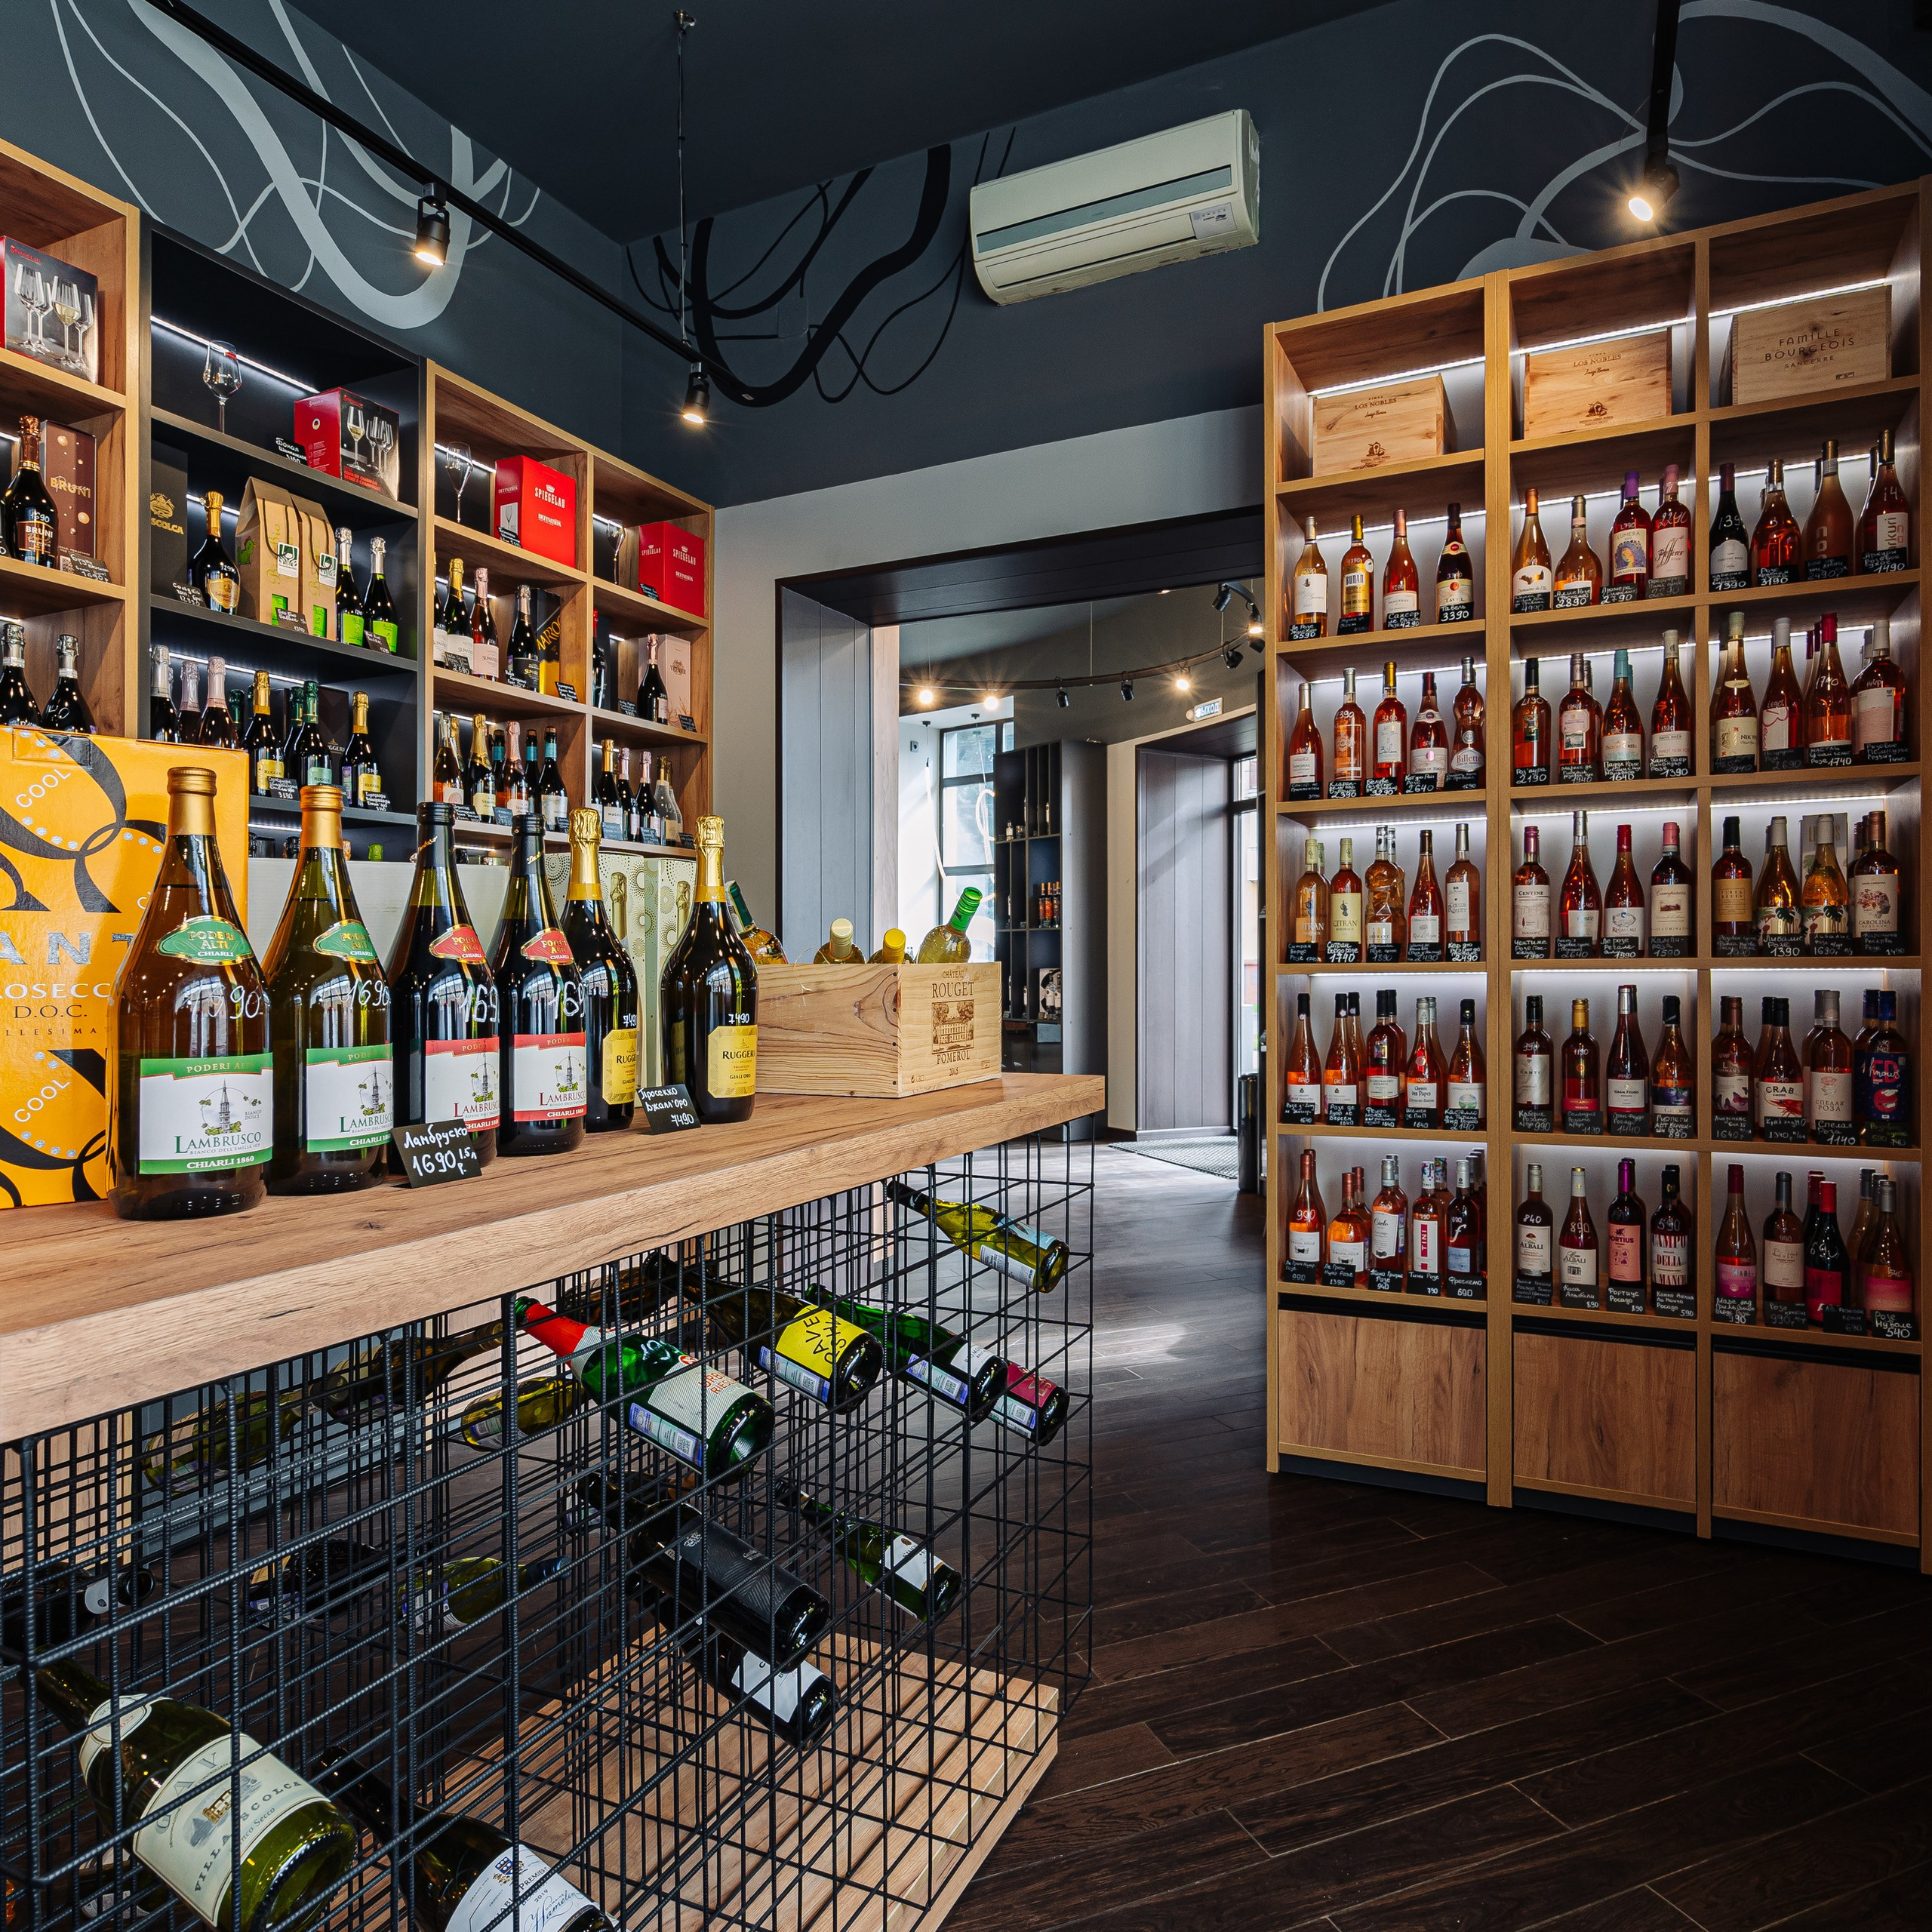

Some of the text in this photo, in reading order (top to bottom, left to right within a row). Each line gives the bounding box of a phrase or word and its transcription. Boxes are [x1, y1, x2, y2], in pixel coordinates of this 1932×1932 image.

[1779, 328, 1840, 346] FAMILLE
[1765, 337, 1854, 361] BOURGEOIS
[1590, 354, 1621, 365] NOBLES
[1785, 355, 1834, 369] SANCERRE
[1370, 398, 1397, 408] NOBLES
[51, 478, 91, 498] BRUNI
[534, 487, 565, 509] SPIEGELAU
[151, 518, 183, 534] SCOLCA
[26, 526, 53, 537] BRUNI
[641, 547, 661, 555] SPIEGELAU
[672, 549, 696, 565] SPIEGELAU
[1873, 563, 1905, 574] 1490
[1715, 581, 1746, 590] 1390
[1761, 577, 1788, 586] 3190
[1649, 586, 1680, 598] 2290
[1555, 598, 1586, 608] 2890
[1601, 594, 1632, 605] 2790
[1441, 611, 1469, 621] 3390
[1815, 676, 1839, 690] 1740
[1457, 754, 1481, 764] Billette
[1827, 757, 1852, 767] 1740
[1773, 760, 1801, 771] 2690
[1609, 773, 1635, 781] 1640
[1660, 768, 1688, 777] 1390
[1516, 774, 1547, 784] 2190
[16, 768, 71, 809] COOL
[1405, 784, 1434, 793] 2640
[1333, 919, 1358, 928] CITRAN
[188, 931, 234, 941] PODERI
[201, 940, 229, 949] ALTI
[1372, 952, 1393, 961] 1890
[1654, 949, 1681, 957] 1590
[1770, 947, 1801, 957] 1390
[1330, 953, 1355, 962] 1740
[1414, 954, 1439, 962] 2490
[1451, 954, 1478, 962] 2490
[346, 980, 390, 1008] 1690
[932, 982, 974, 998] ROUGET
[14, 1005, 87, 1019] D.O.C.
[728, 1014, 749, 1024] 7490
[937, 1051, 970, 1065] POMEROL
[187, 1063, 229, 1073] PODERI
[949, 1067, 959, 1076] 2015
[638, 1088, 678, 1100] Просекко
[1765, 1086, 1795, 1094] CRAB
[14, 1079, 71, 1122] COOL
[671, 1113, 694, 1127] 7490
[1534, 1122, 1551, 1132] 990
[1817, 1121, 1853, 1130] Спелая
[404, 1124, 467, 1149] Ламбруско
[1716, 1130, 1739, 1139] 1640
[1817, 1127, 1842, 1136] Роза
[174, 1132, 261, 1154] LAMBRUSCO
[349, 1136, 382, 1146] CHIARLI
[1826, 1136, 1856, 1146] 1140
[186, 1159, 234, 1169] CHIARLI
[413, 1149, 457, 1177] 1690
[1296, 1209, 1316, 1220] 990
[1522, 1214, 1542, 1223] 840
[1374, 1217, 1389, 1227] Cielo
[1570, 1223, 1590, 1233] 890
[1657, 1254, 1681, 1266] DELLA
[1887, 1268, 1903, 1278] 540
[1457, 1288, 1473, 1297] 690
[1608, 1287, 1640, 1297] Фортиус
[1609, 1296, 1633, 1304] Росадо
[1717, 1297, 1737, 1306] Маре
[1657, 1303, 1678, 1311] Росадо
[1769, 1303, 1788, 1312] Розе
[1728, 1314, 1746, 1324] 990
[1770, 1315, 1790, 1324] 990
[1875, 1312, 1896, 1321] Розе
[1845, 1324, 1863, 1332] 690
[1885, 1327, 1910, 1338] 540
[254, 1807, 275, 1826] Secco
[195, 1781, 302, 1892] VILLA SCOLCA
[534, 1889, 548, 1903] 2019
[546, 1894, 565, 1911] DOMAINE
